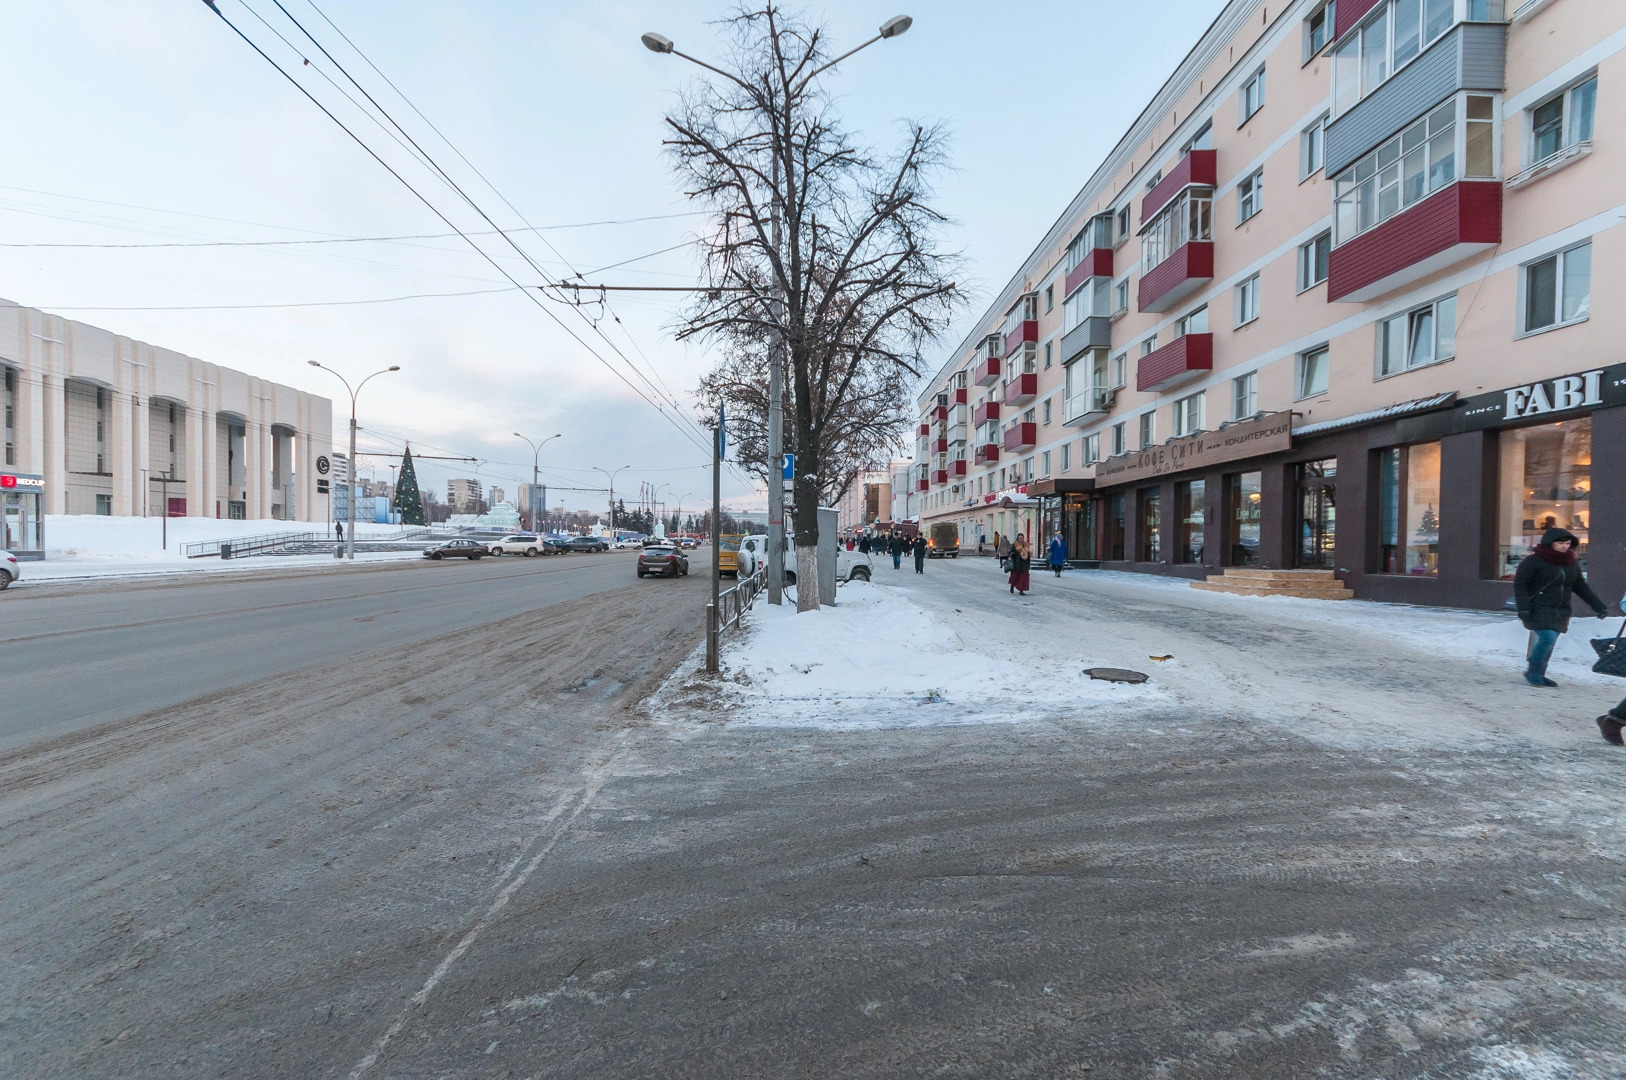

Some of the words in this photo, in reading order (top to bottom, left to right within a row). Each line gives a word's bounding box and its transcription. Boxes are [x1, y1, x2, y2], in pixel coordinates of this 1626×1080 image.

[1465, 405, 1501, 416] SINCE
[1503, 370, 1604, 420] FABI
[1138, 451, 1164, 469] КОФЕ
[1171, 440, 1204, 460] СИТИ
[1224, 424, 1288, 446] КОНДИТЕРСКАЯ
